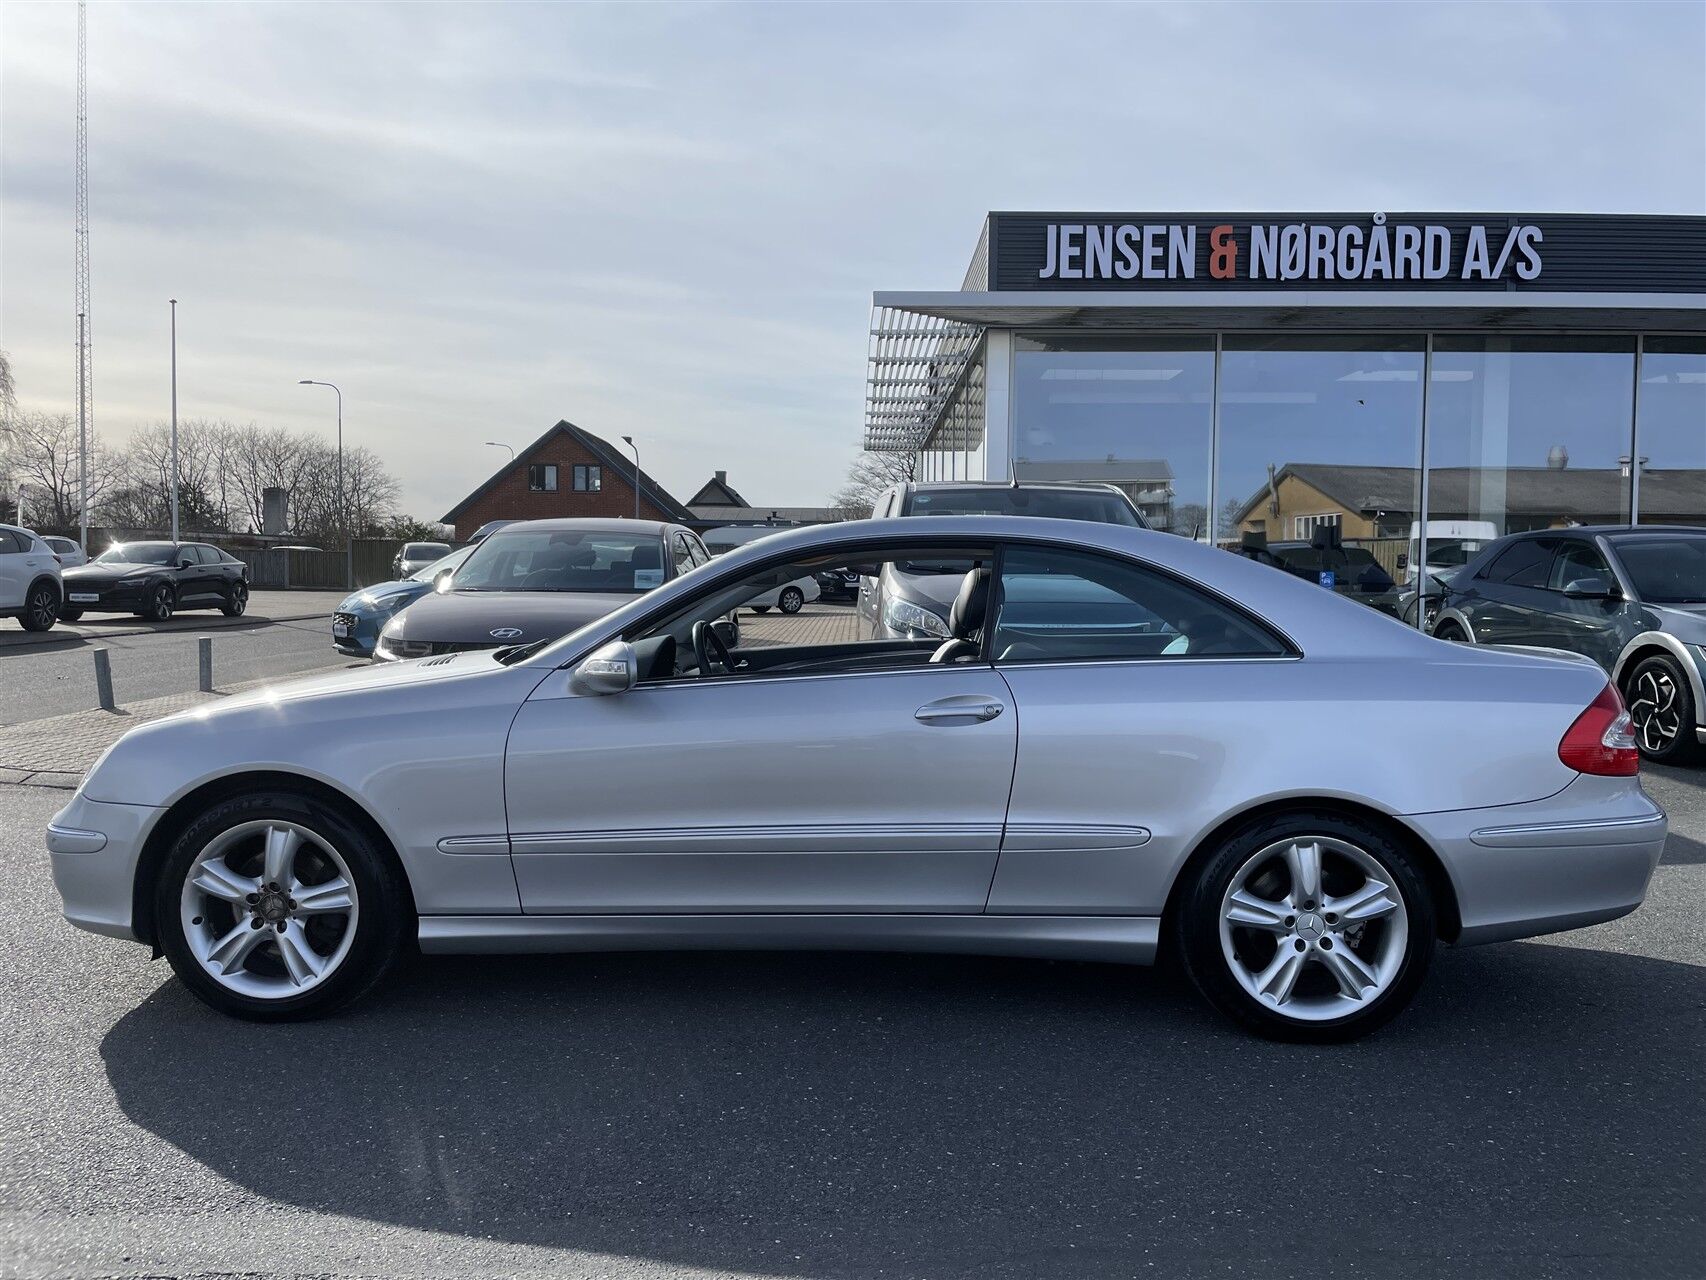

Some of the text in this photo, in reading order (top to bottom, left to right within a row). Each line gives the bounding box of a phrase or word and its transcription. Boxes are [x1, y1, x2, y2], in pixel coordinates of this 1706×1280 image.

[1039, 212, 1544, 281] JENSEN & NØRGÅRD A/S
